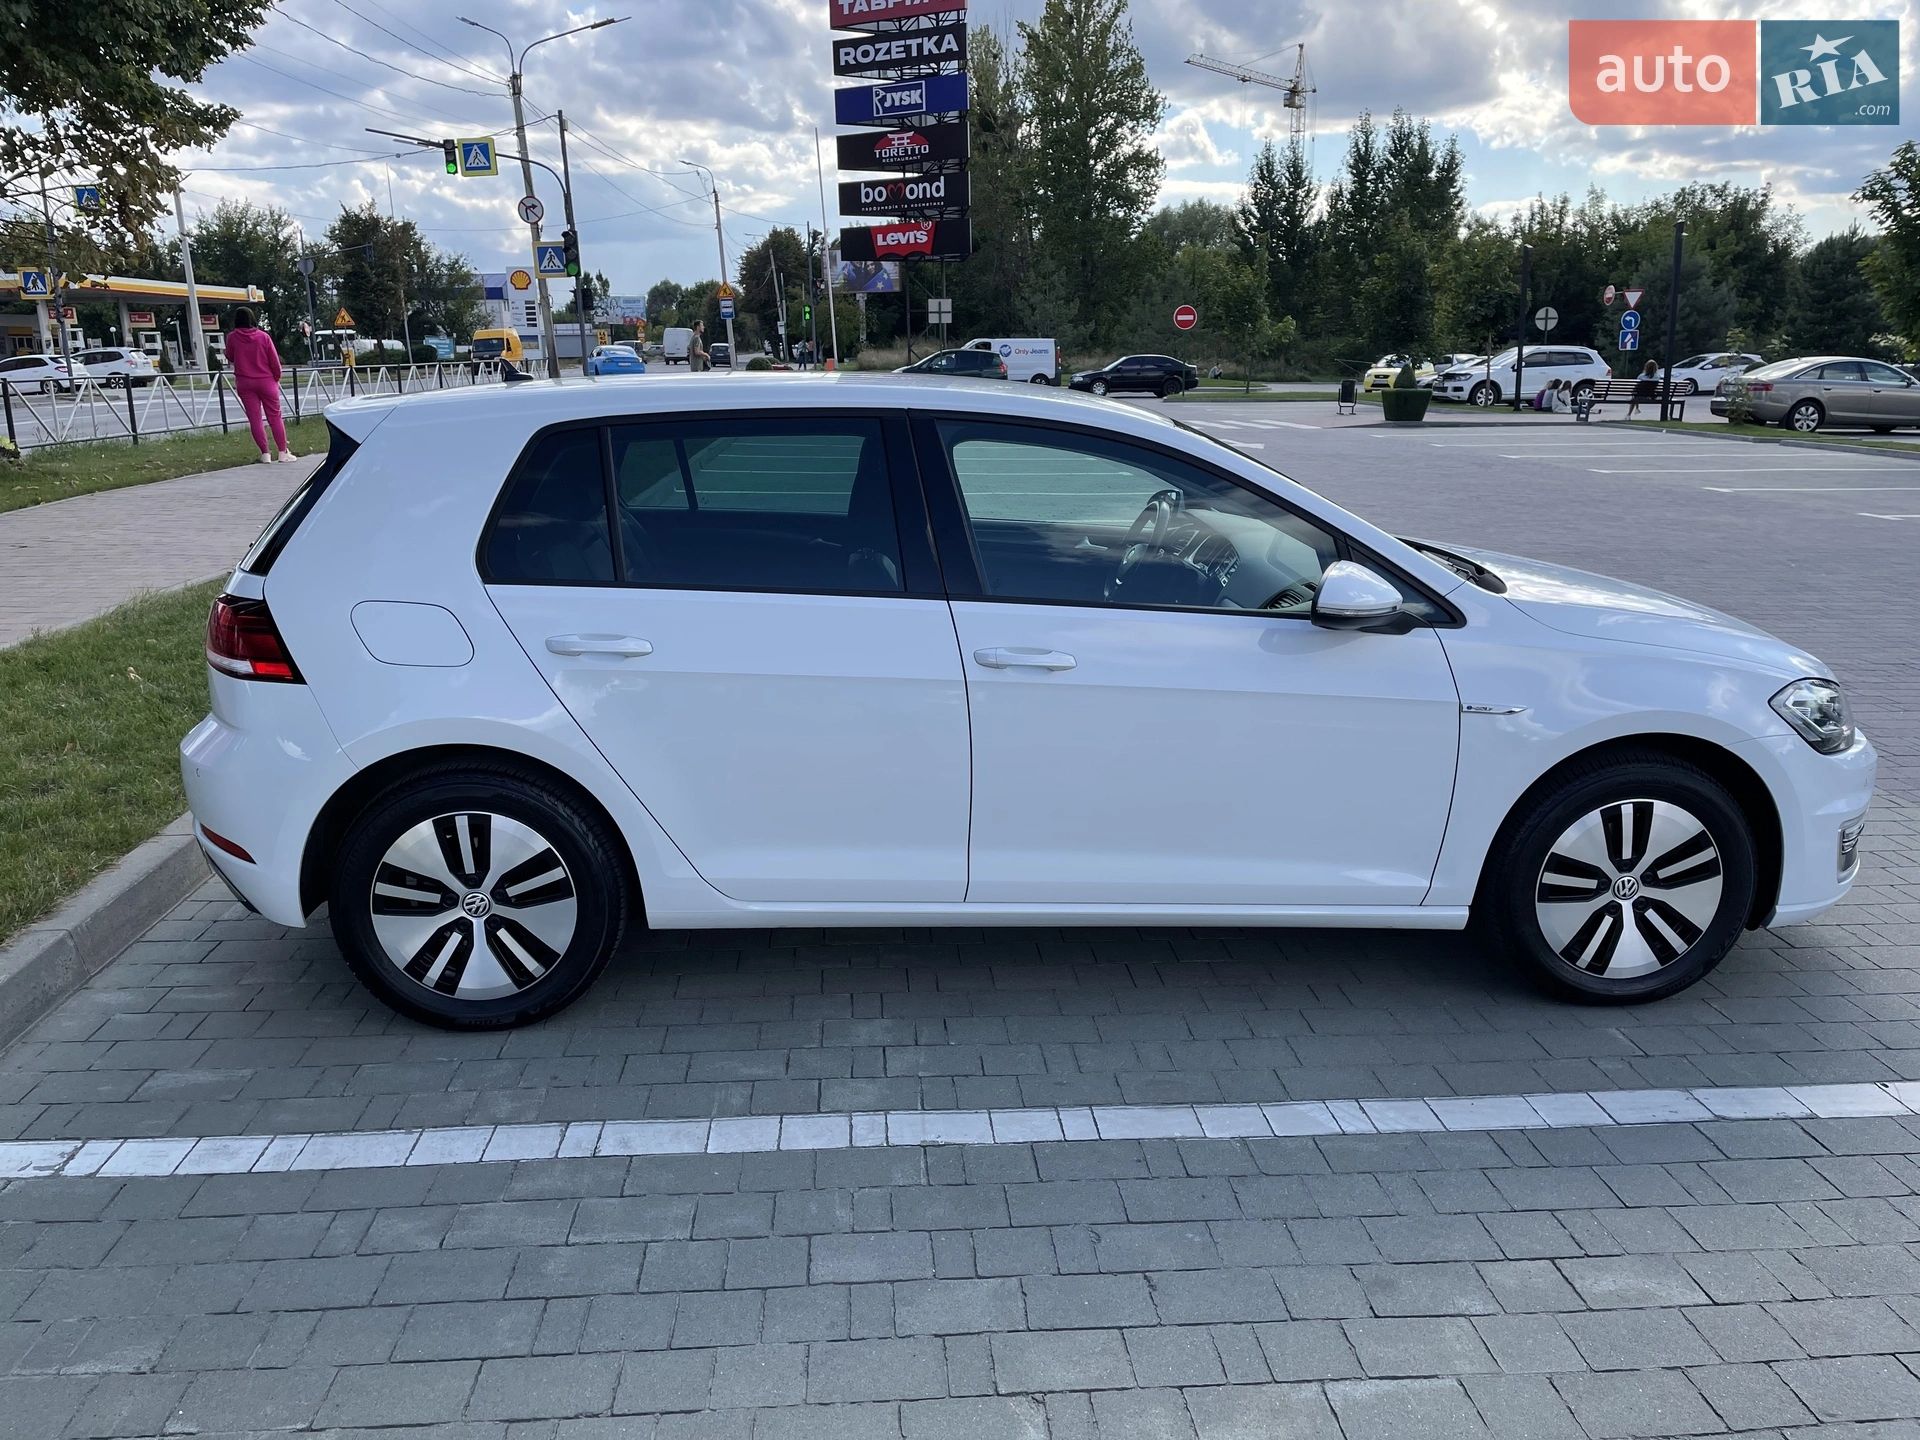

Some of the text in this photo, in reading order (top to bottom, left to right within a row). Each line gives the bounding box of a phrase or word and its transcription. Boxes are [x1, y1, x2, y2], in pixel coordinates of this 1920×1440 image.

[839, 33, 959, 66] ROZETKA
[883, 88, 922, 108] JYSK
[874, 144, 929, 159] TORETTO
[882, 155, 921, 163] RESTAURANT
[1030, 347, 1050, 355] Jeans
